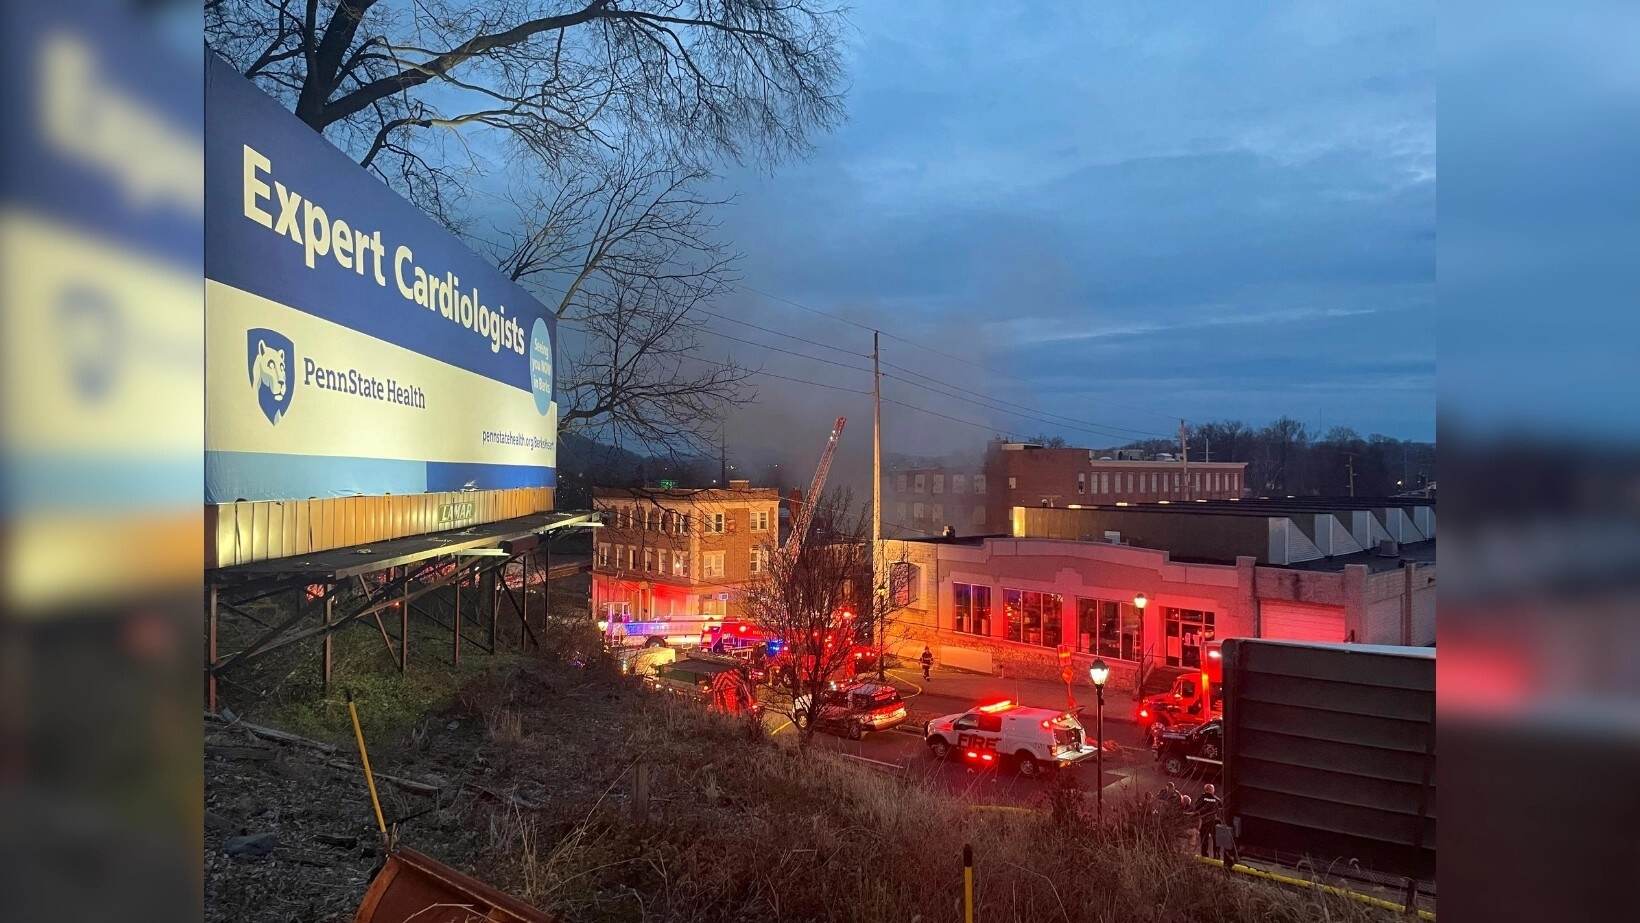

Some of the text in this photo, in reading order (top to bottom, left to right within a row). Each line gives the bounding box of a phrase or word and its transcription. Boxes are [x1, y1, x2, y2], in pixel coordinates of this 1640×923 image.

[243, 144, 525, 355] Expert Cardiologists
[303, 357, 426, 409] PennState Health
[441, 503, 473, 521] LAMAR
[957, 733, 999, 750] FIRE
